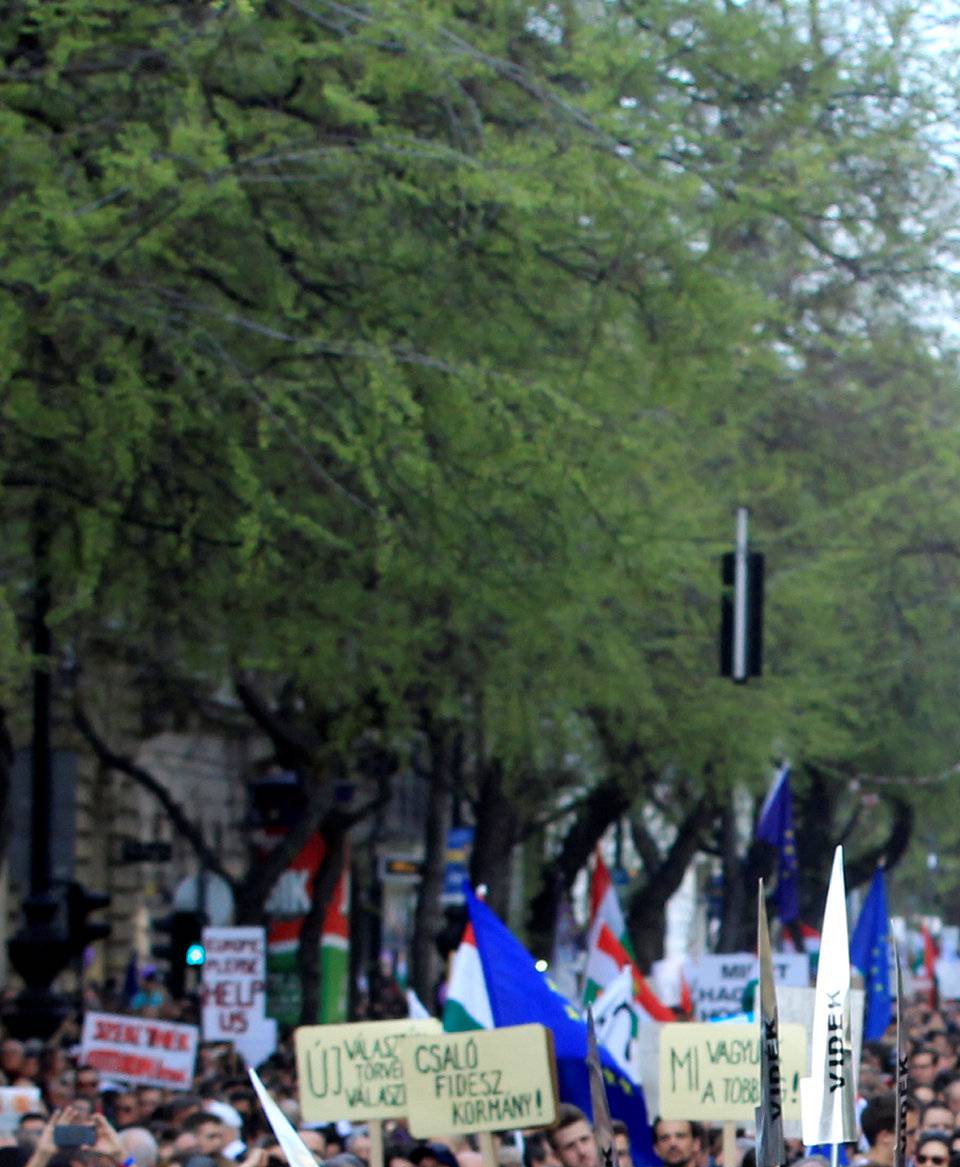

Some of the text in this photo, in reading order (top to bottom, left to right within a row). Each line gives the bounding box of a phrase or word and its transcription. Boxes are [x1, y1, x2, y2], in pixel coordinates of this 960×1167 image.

[219, 1012, 249, 1034] US
[306, 1039, 342, 1099] ÚJ
[415, 1036, 478, 1074] CSALÓ
[670, 1044, 699, 1093] MI
[435, 1069, 503, 1098] FIDESZ
[702, 1079, 716, 1103] A
